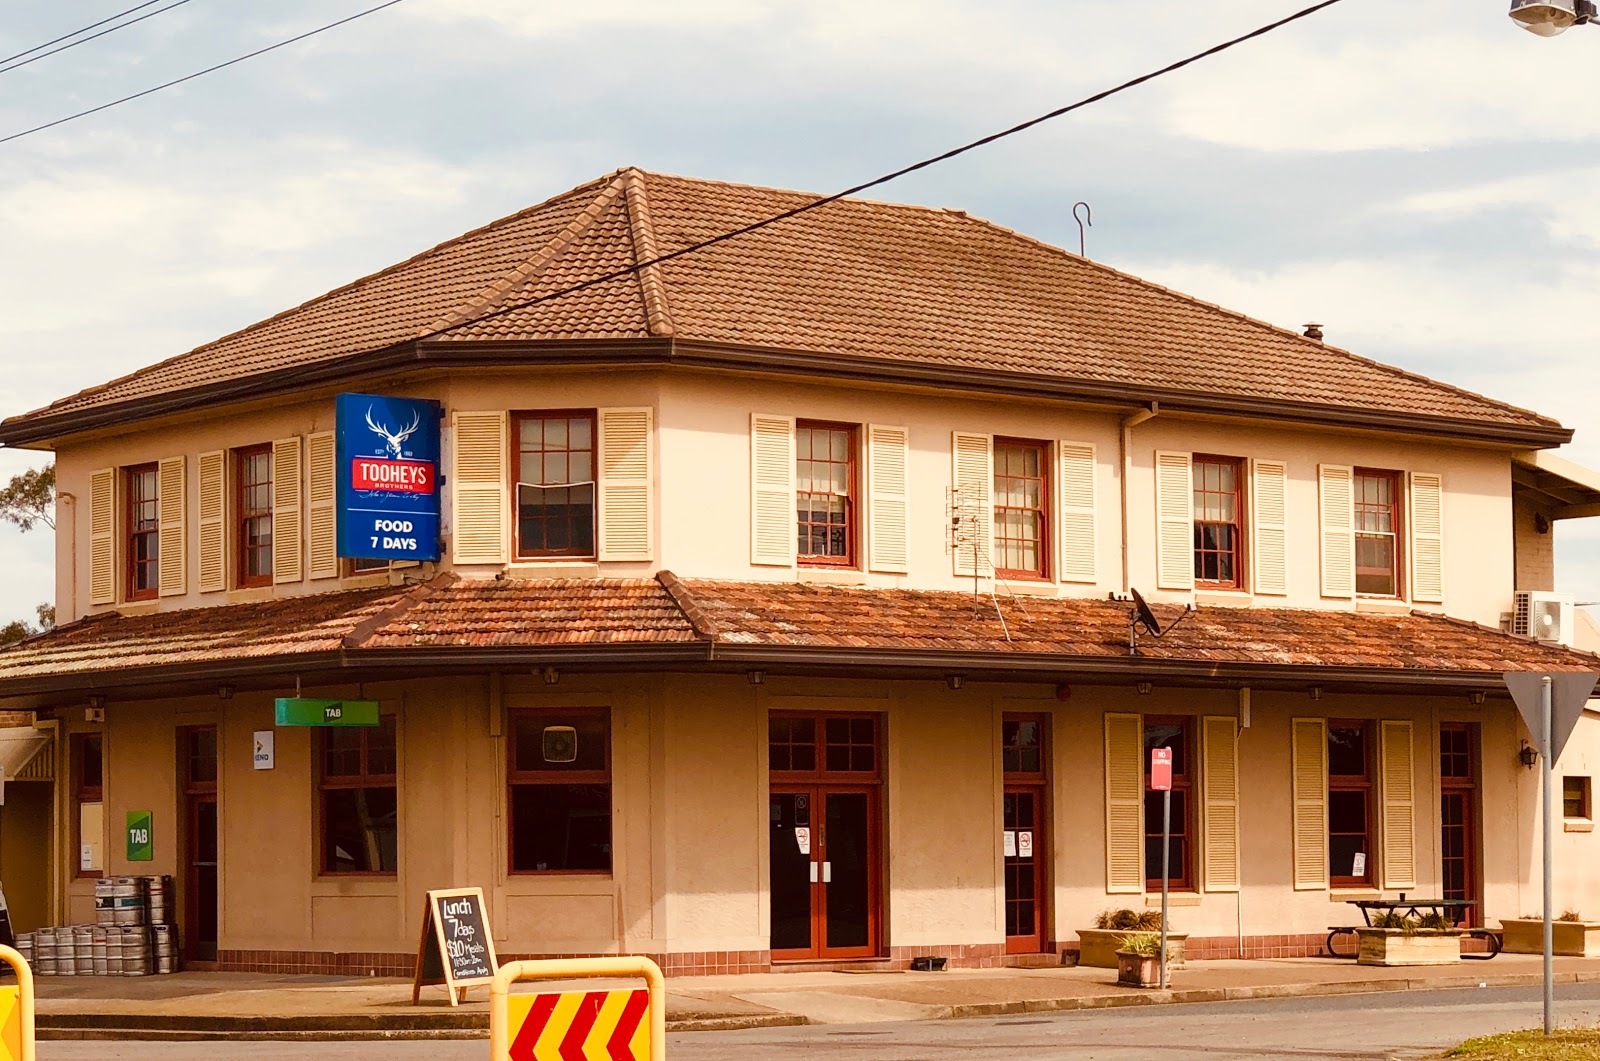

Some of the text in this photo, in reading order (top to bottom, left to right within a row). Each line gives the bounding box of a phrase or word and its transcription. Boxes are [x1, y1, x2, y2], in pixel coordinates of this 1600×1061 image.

[360, 463, 426, 485] TOOHEYS
[375, 519, 413, 533] FOOD
[370, 536, 417, 550] 7 DAYS
[325, 708, 341, 717] TAB
[130, 829, 148, 844] TAB
[443, 897, 472, 919] Lunch
[448, 918, 475, 942] 7 days
[446, 938, 465, 959] $10
